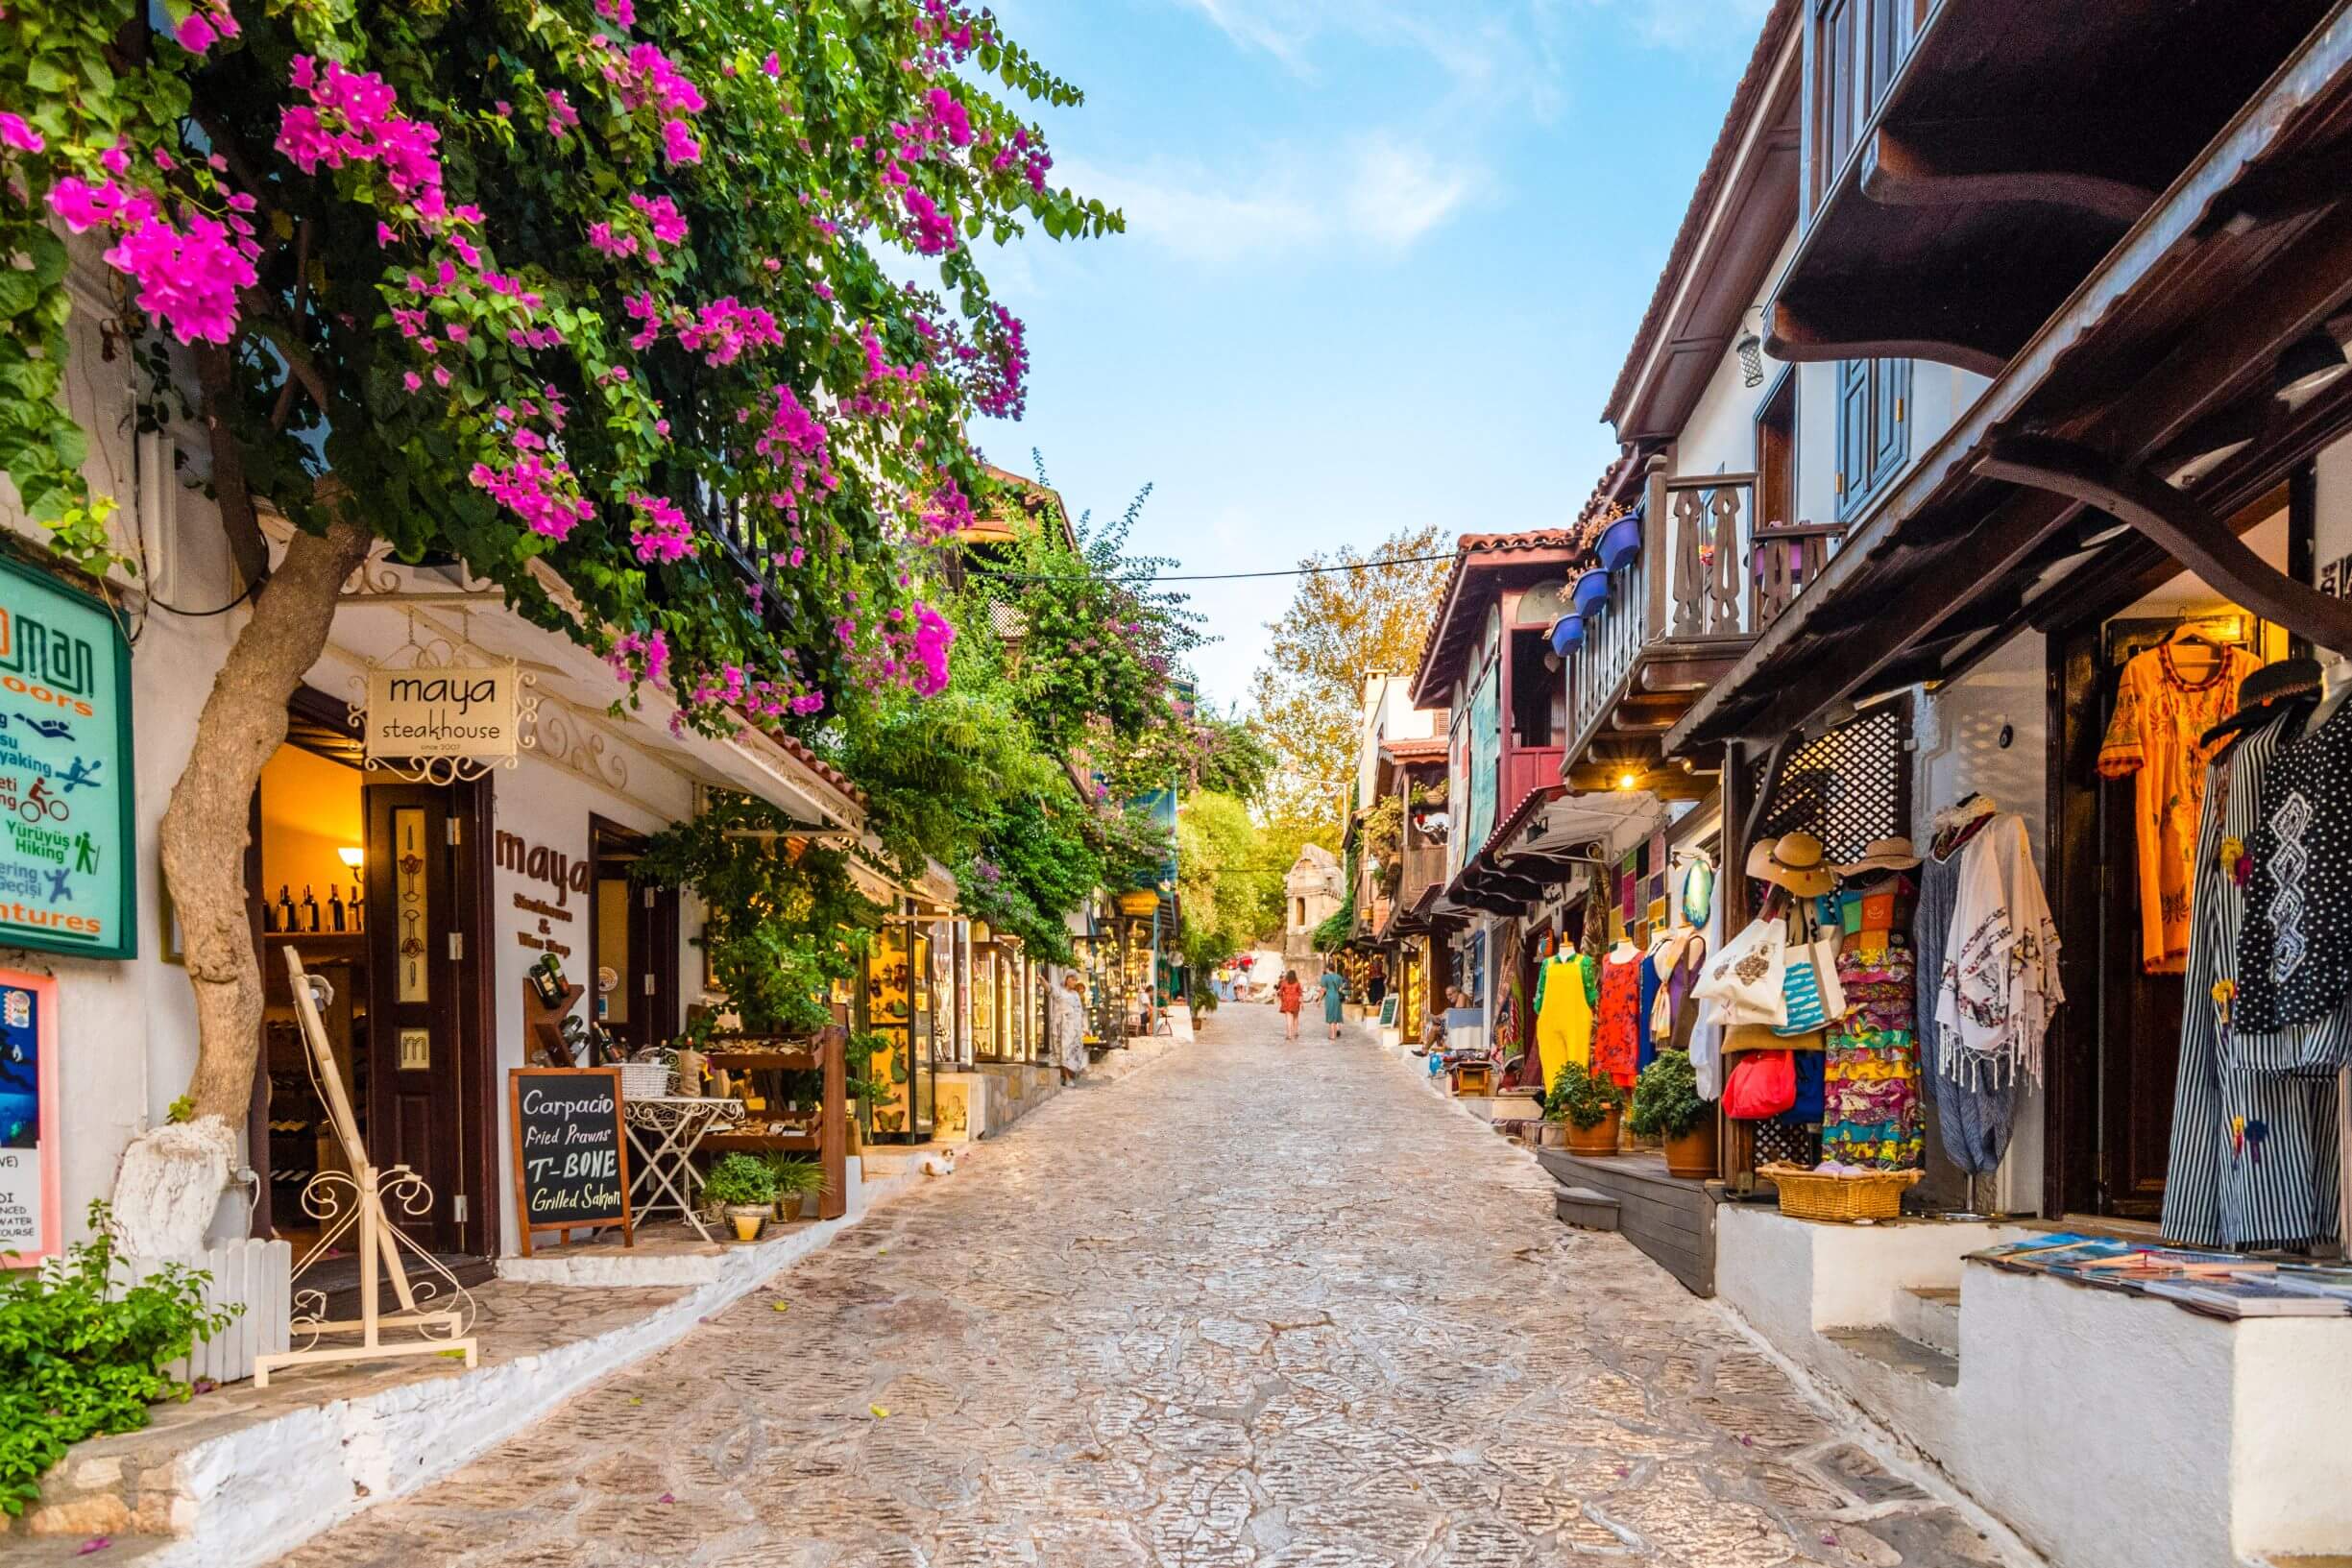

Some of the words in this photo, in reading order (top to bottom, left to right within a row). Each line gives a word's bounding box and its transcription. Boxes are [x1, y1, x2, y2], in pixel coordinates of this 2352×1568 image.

[391, 679, 495, 714] maya
[383, 709, 500, 740] steakhouse
[7, 820, 70, 852] Yürüyüş
[15, 837, 64, 863] Hiking
[496, 830, 591, 906] maya
[523, 1090, 614, 1121] Carpacio
[565, 1123, 612, 1145] Prawns
[527, 1150, 617, 1183] T-BONE
[532, 1188, 578, 1211] Grilled
